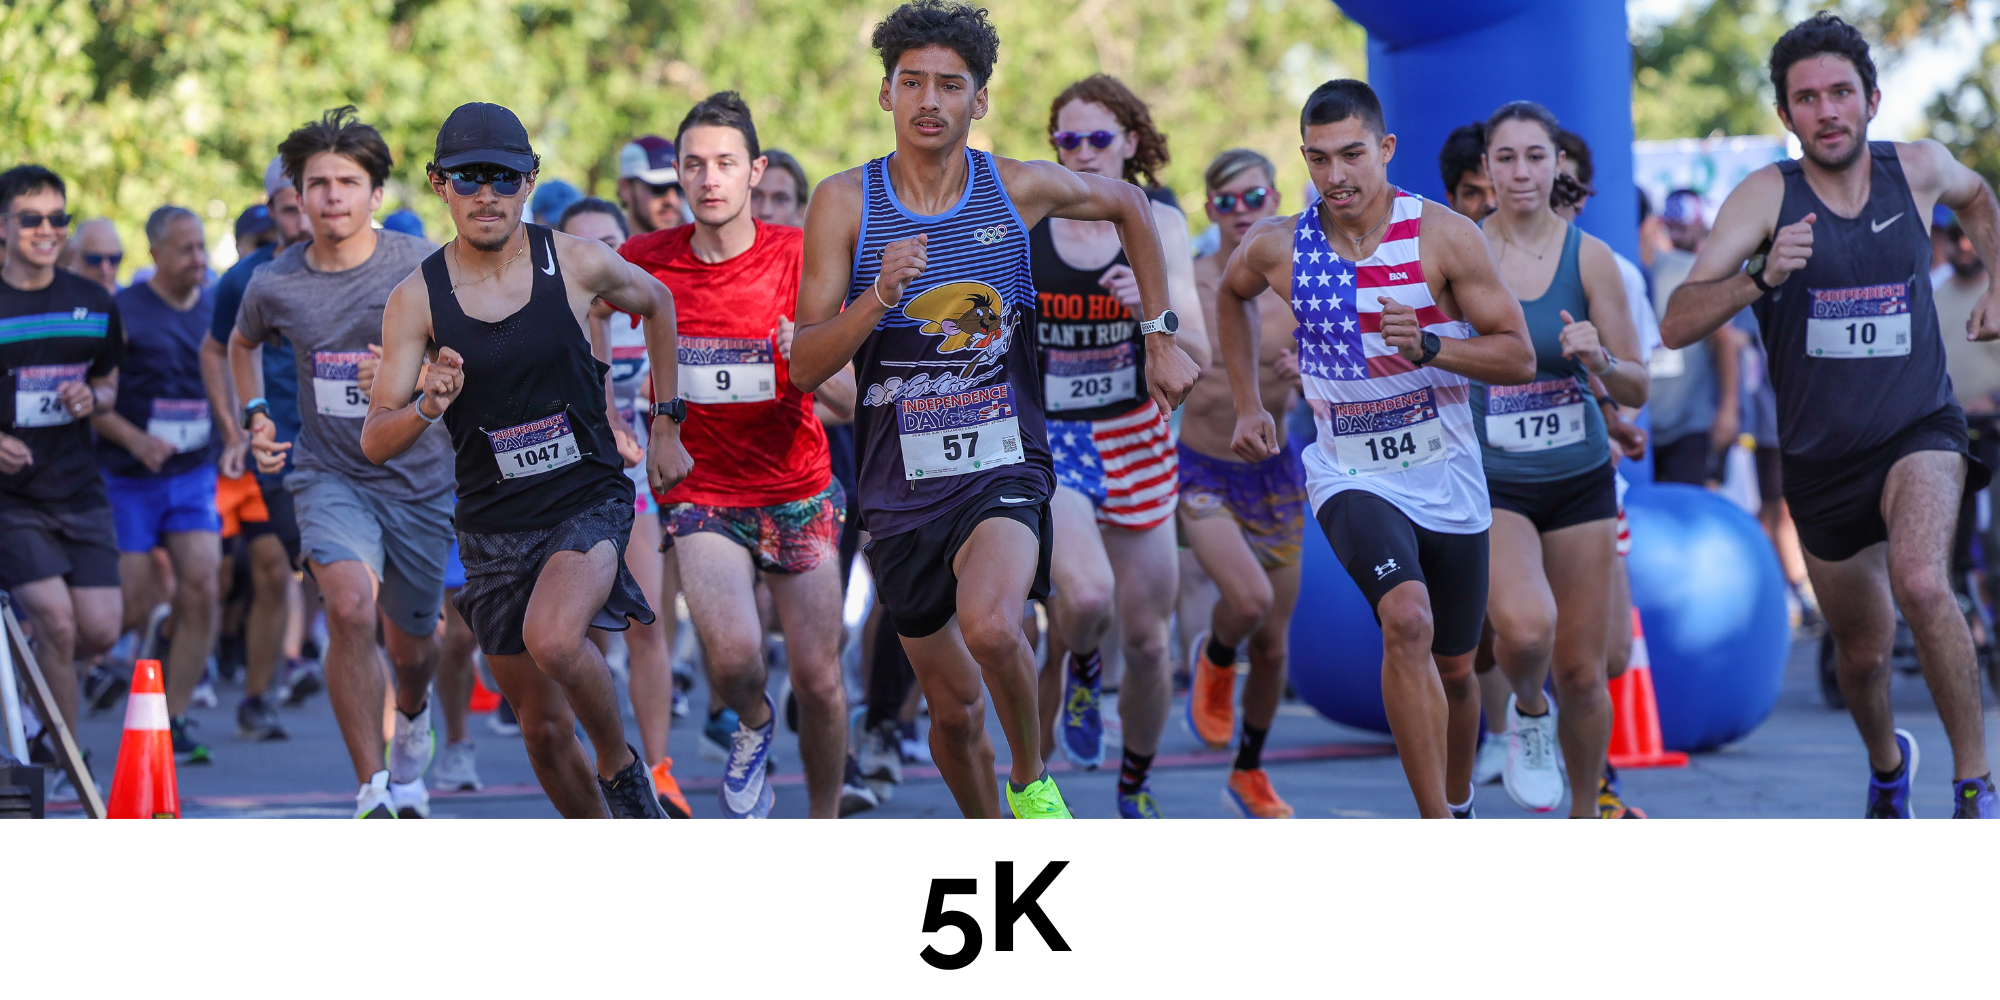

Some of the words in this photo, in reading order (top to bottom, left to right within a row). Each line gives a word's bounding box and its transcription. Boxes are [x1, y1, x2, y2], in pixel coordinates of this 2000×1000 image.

[1038, 292, 1084, 320] TOO
[1037, 321, 1093, 347] CAN'T
[1095, 320, 1136, 346] RUN
[1846, 322, 1877, 345] 10
[716, 370, 731, 391] 9
[1071, 377, 1113, 398] 203
[903, 385, 1008, 413] INDEPENDENCE
[1335, 389, 1429, 416] INDEPENDENCE
[492, 414, 564, 441] INDEPENDENCE
[1515, 413, 1560, 438] 179
[513, 442, 559, 468] 1047
[943, 431, 979, 461] 57
[1365, 432, 1417, 461] 184
